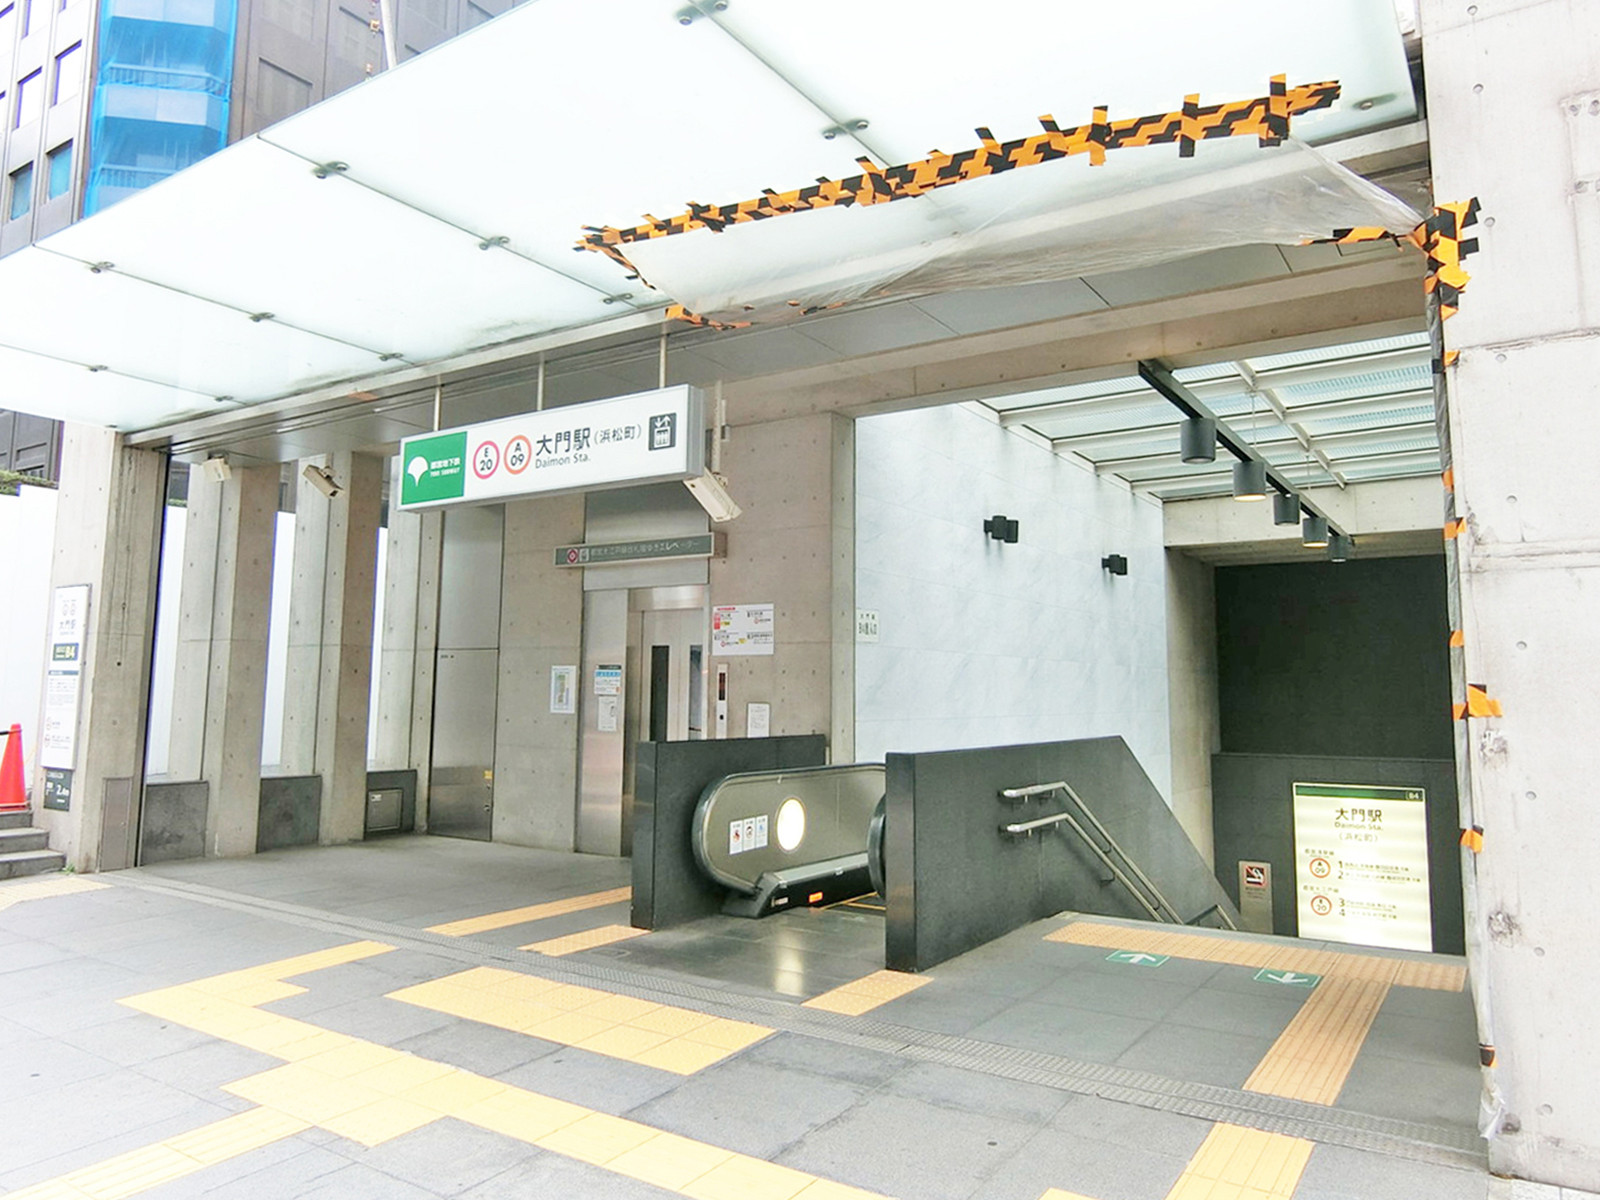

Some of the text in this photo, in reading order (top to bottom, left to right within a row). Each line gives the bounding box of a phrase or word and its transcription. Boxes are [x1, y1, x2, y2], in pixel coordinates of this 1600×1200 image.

[514, 442, 522, 452] A
[536, 427, 591, 456] 大門駅
[484, 447, 490, 457] E
[480, 459, 493, 471] 20
[510, 453, 525, 466] 09
[535, 453, 591, 469] Daimon Sta.
[1335, 808, 1382, 822] 大門駅
[1338, 870, 1344, 880] 2
[1339, 898, 1346, 907] 3
